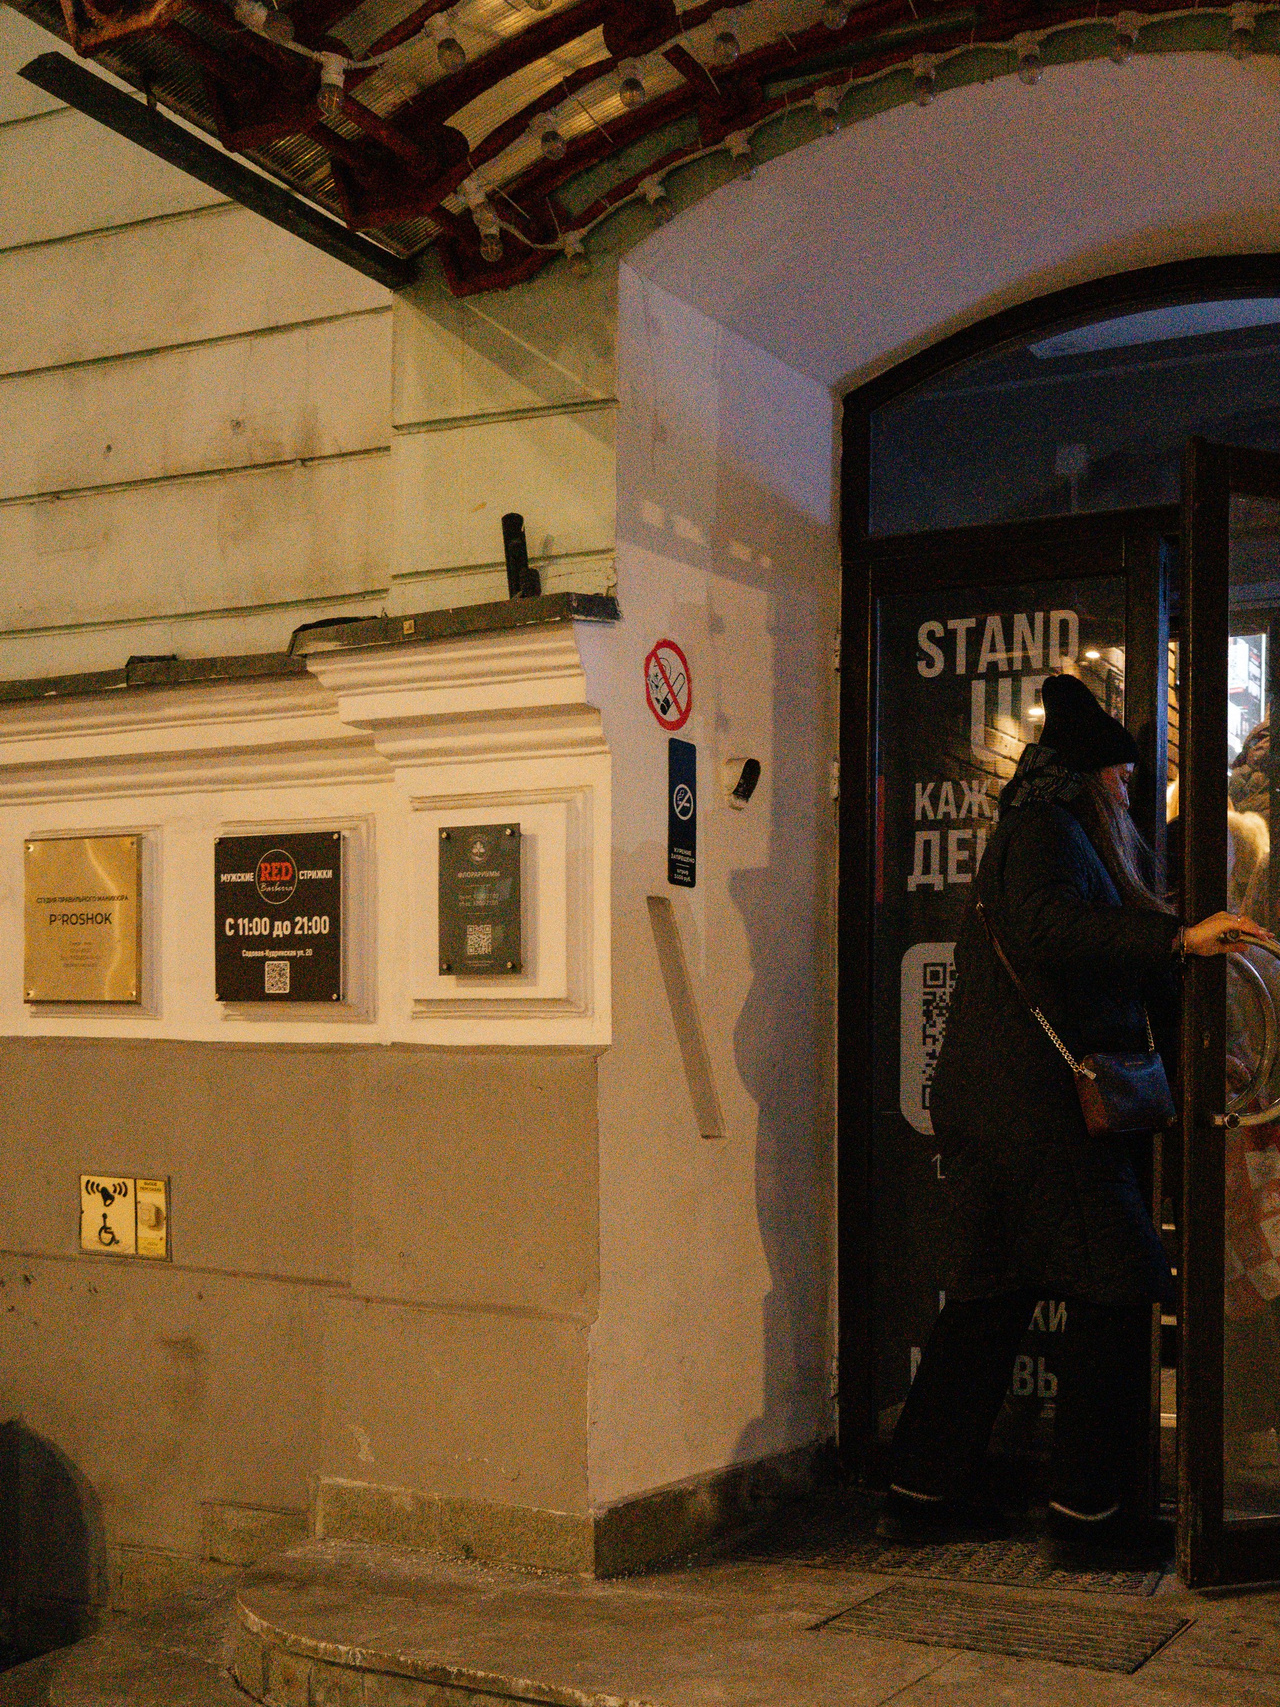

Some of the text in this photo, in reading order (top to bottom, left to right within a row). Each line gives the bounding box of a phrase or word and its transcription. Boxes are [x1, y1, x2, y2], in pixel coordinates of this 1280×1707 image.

[917, 609, 1079, 678] STAND
[220, 872, 254, 883] МУЖСКИЕ
[259, 861, 293, 882] RED
[298, 869, 333, 880] СТРИЖКИ
[225, 915, 330, 938] С 11:00 до 21:00
